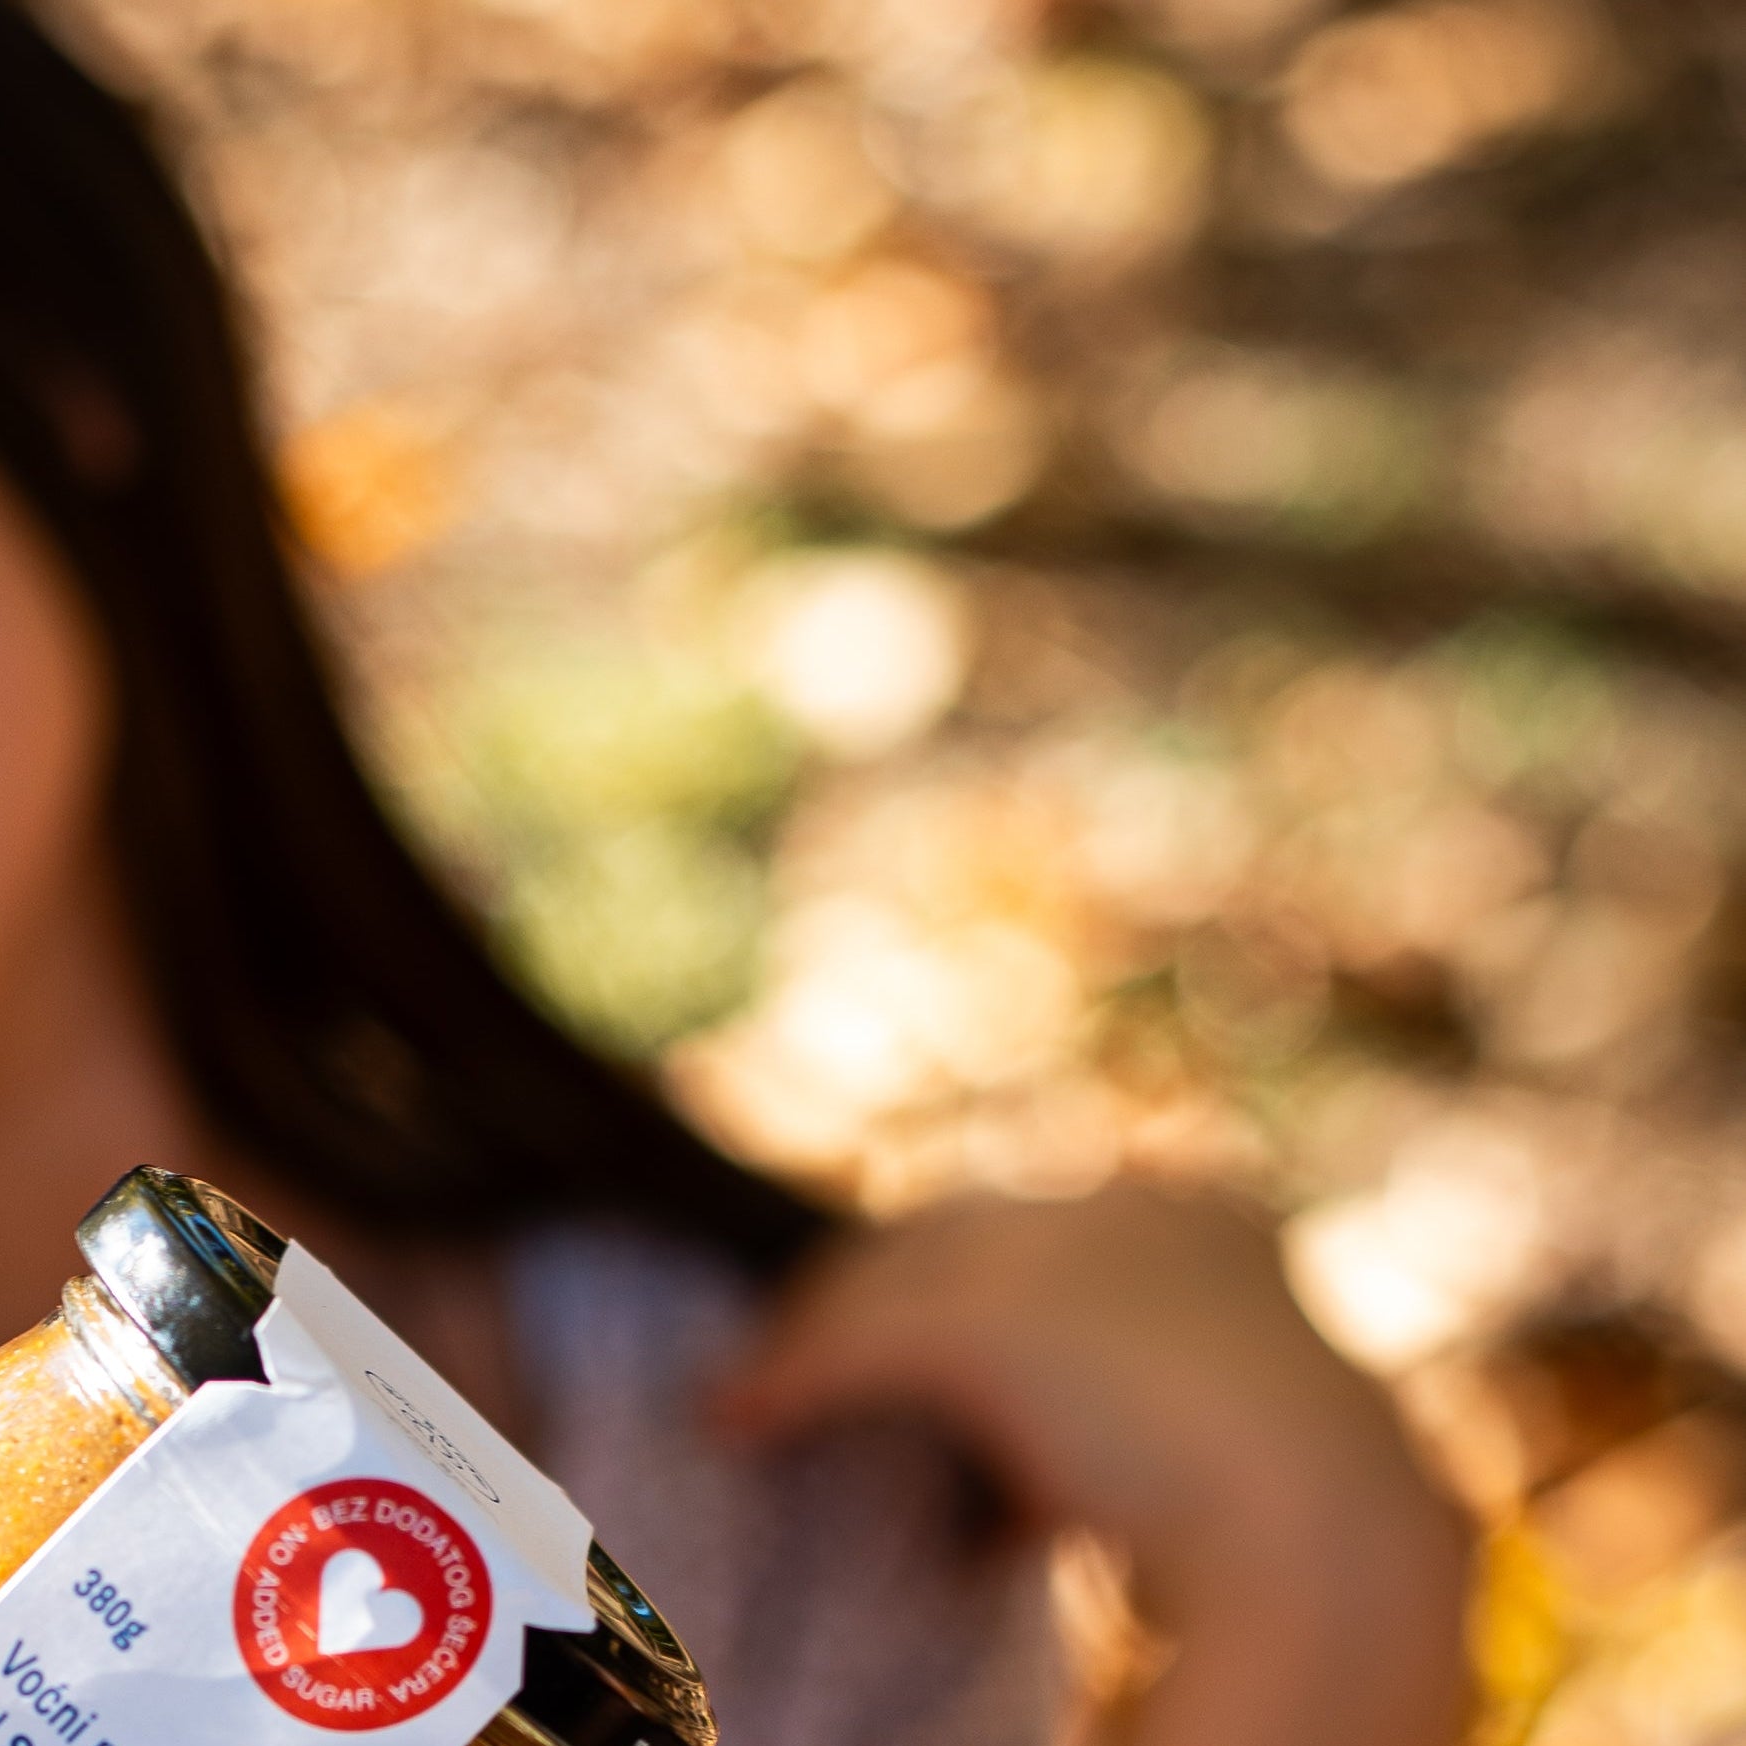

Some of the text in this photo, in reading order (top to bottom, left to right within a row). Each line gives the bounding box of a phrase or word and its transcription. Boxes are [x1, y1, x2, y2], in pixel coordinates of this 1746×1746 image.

[310, 1496, 370, 1531] BEZ
[373, 1498, 478, 1610] DODATOG
[73, 1568, 148, 1652] 380g
[252, 1523, 376, 1712] NO ADDED SUGAR
[0, 1640, 99, 1743] Voćni
